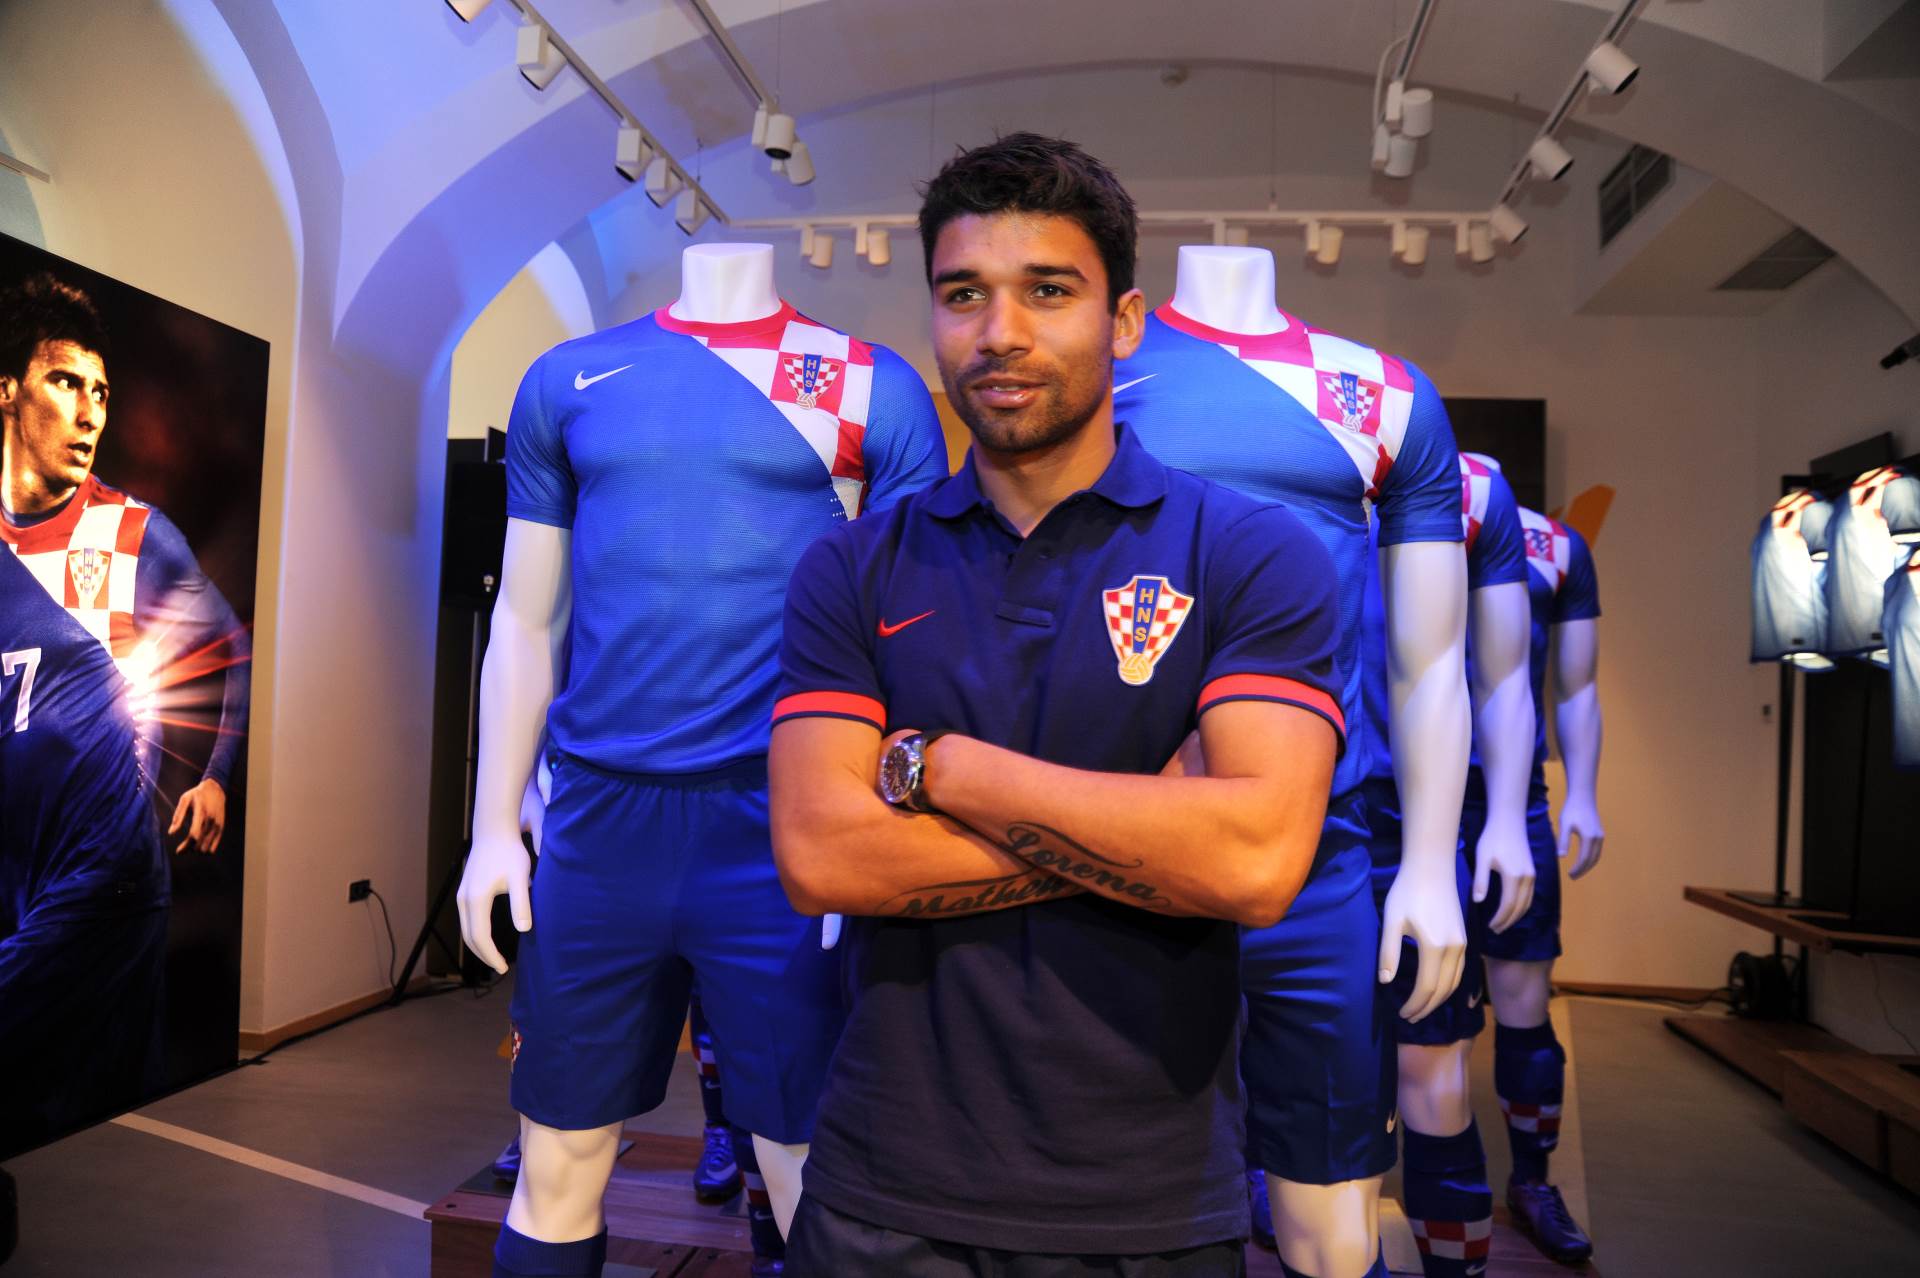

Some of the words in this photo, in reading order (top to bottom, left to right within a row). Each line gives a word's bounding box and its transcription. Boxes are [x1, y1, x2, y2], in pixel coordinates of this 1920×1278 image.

[806, 359, 817, 388] HNS
[1134, 588, 1155, 642] HNS
[0, 648, 42, 733] 7
[1007, 822, 1172, 908] Lorena
